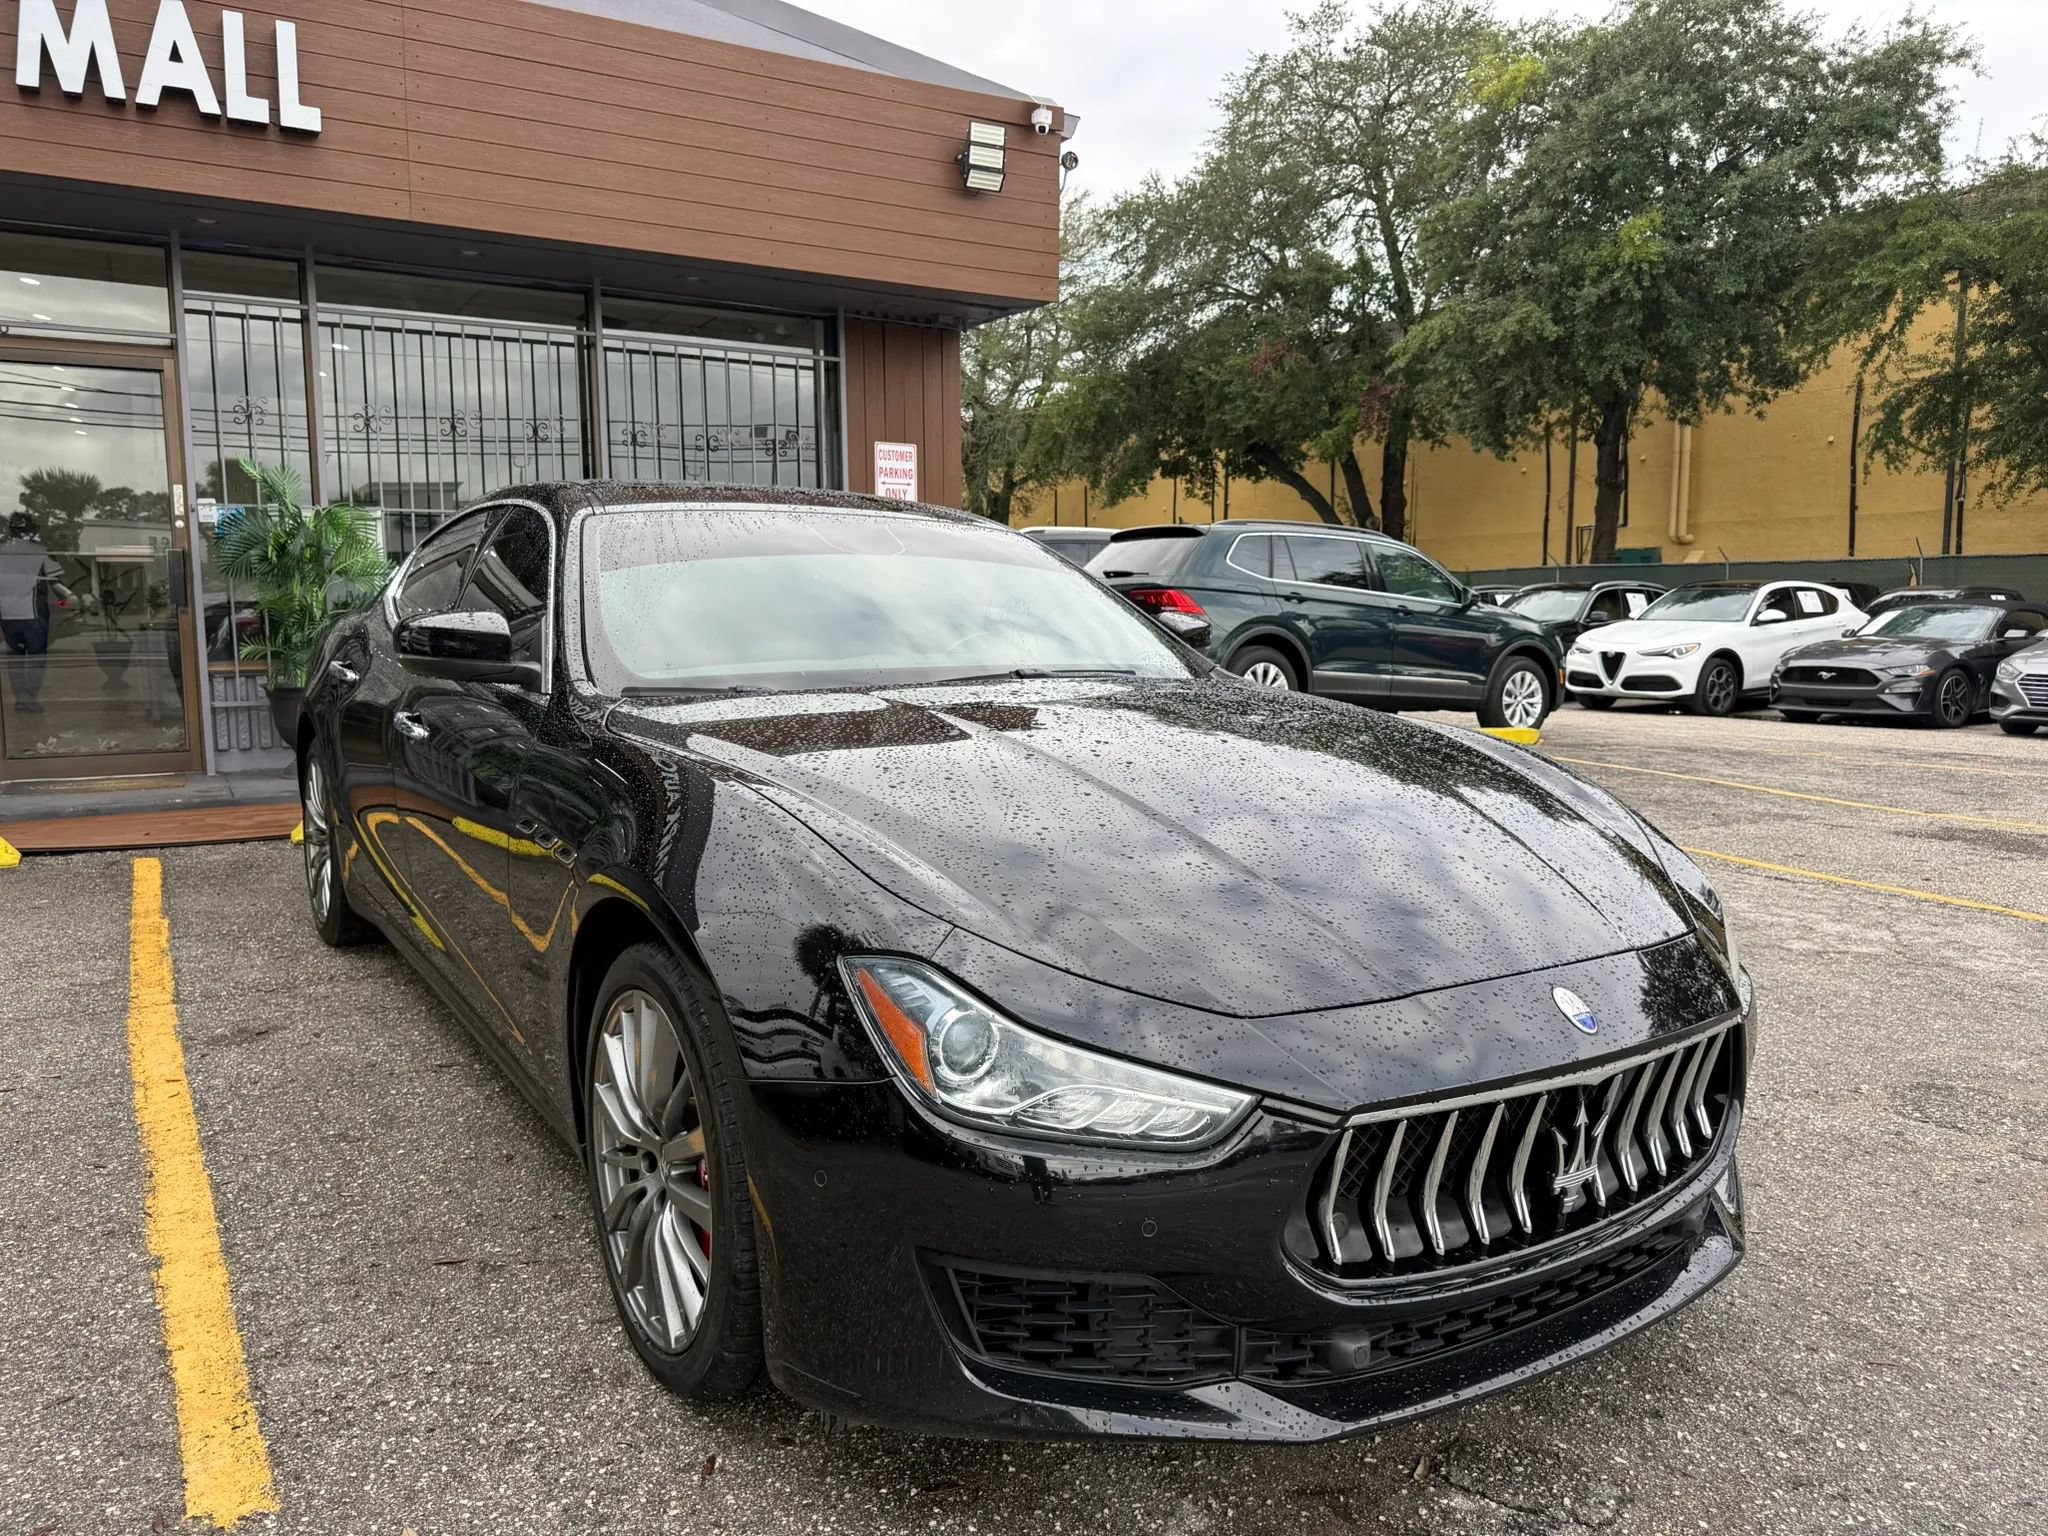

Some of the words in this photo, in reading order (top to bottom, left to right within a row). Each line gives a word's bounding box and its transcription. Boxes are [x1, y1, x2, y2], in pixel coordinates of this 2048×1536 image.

[15, 0, 322, 133] MALL
[879, 449, 913, 462] CUSTOMER
[879, 467, 913, 479] PARKING
[885, 488, 907, 500] ONLY
